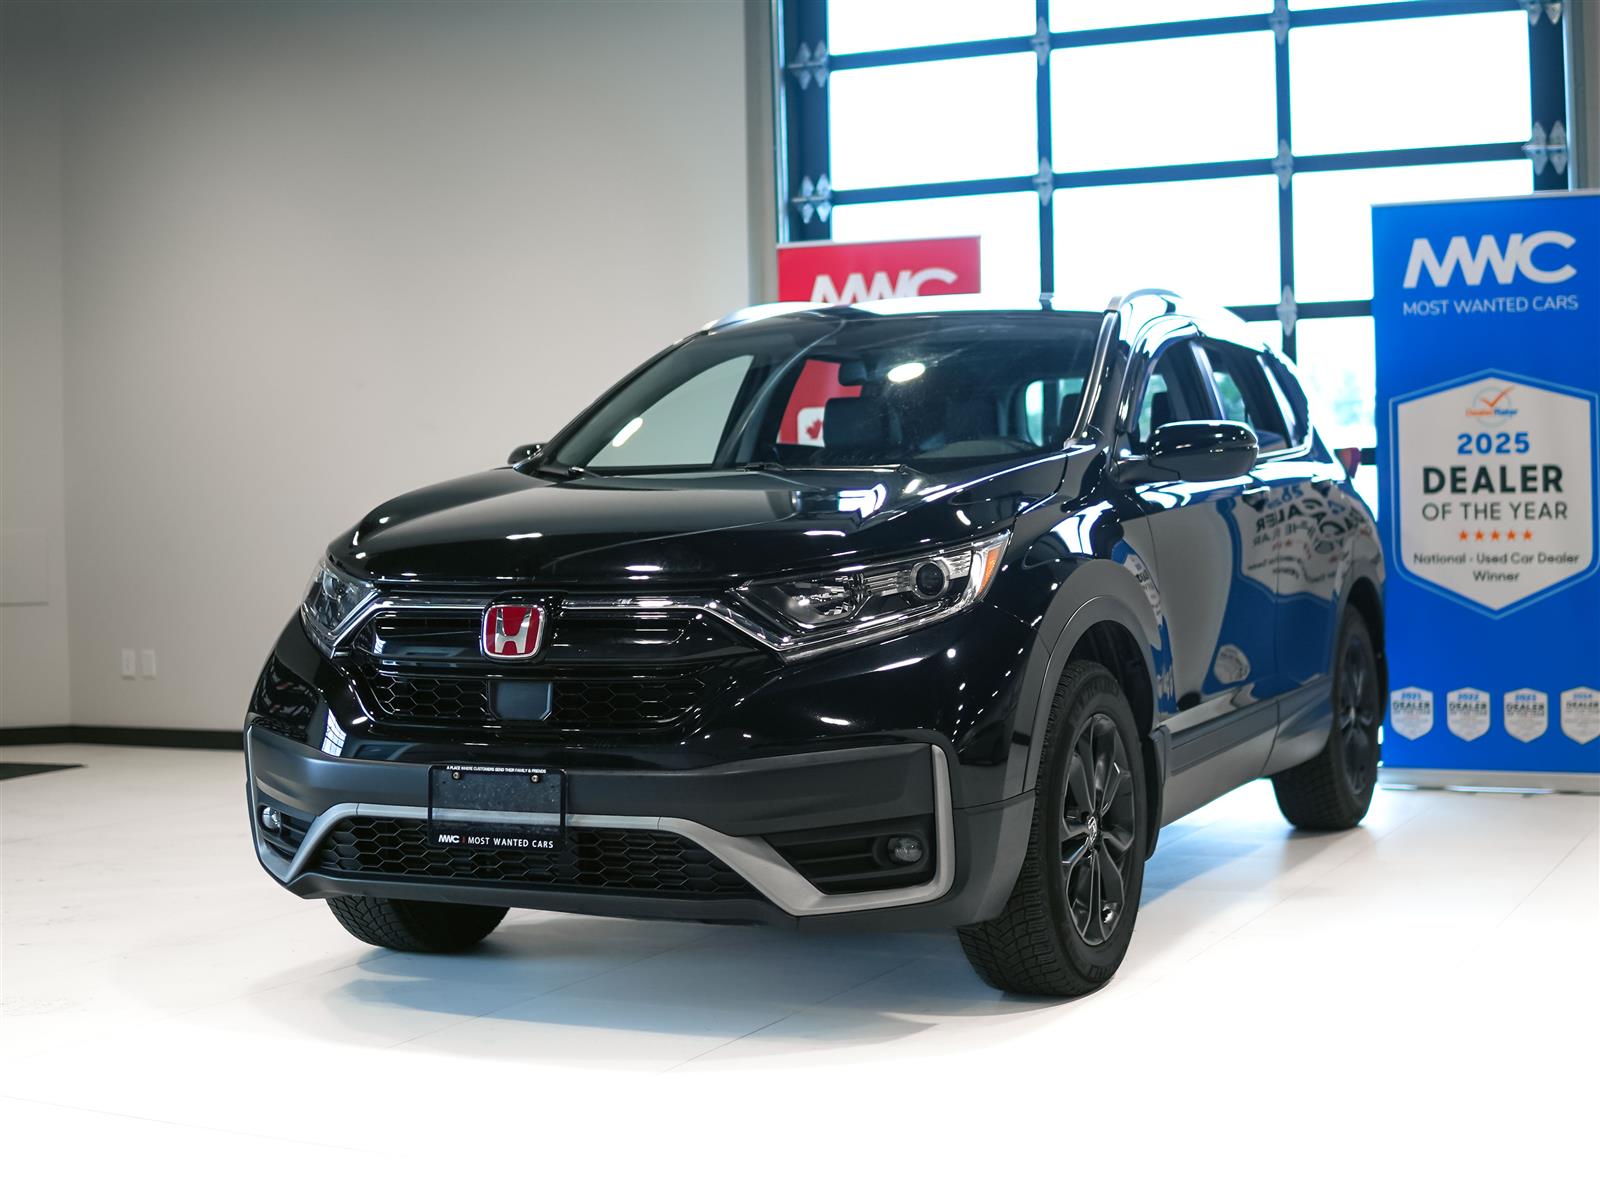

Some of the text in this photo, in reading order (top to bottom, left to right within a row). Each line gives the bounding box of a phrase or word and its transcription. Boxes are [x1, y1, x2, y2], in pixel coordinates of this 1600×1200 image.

[1403, 230, 1577, 289] MWC
[1403, 294, 1579, 316] MOST WANTED CARS
[1457, 432, 1530, 455] 2025
[1423, 464, 1563, 494] DEALER
[1422, 501, 1568, 521] OF THE YEAR
[1413, 552, 1466, 565] National
[1476, 552, 1508, 564] Used
[1511, 552, 1534, 564] Car
[1537, 551, 1579, 564] Dealer
[1473, 571, 1520, 582] Winner
[1393, 702, 1430, 711] DEALER
[1449, 703, 1487, 711] DEALER
[438, 834, 554, 849] MWC MOST WANTED CARS
